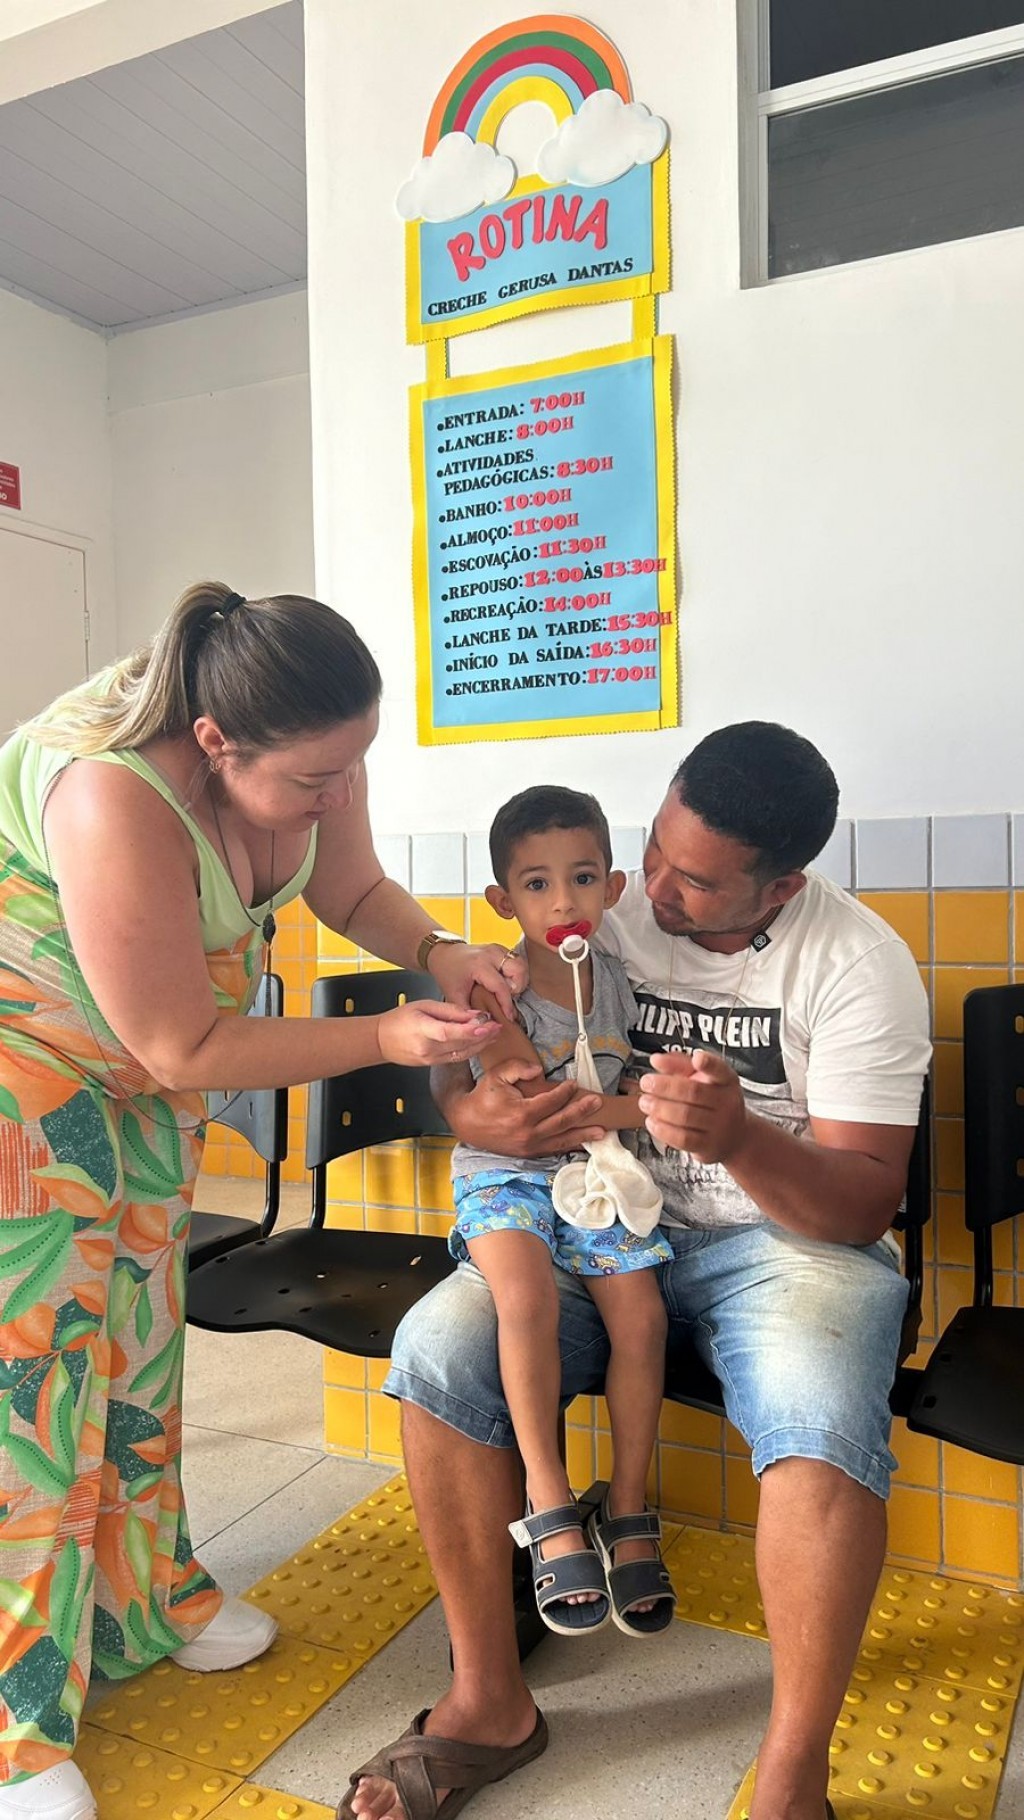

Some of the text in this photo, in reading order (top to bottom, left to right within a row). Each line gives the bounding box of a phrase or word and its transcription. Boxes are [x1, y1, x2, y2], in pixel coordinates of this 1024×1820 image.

[448, 195, 608, 281] ROTINA
[428, 258, 633, 316] CRECHE GERUSA DANTAS
[445, 392, 585, 430] ENTRADA: 7:00H
[445, 416, 574, 453] LANCHE: 8:00H
[443, 449, 534, 477] ATIVIDADES
[444, 456, 613, 496] PEDAGÓGICAS: 8:30H
[446, 488, 572, 522] BANHO: 10:00H
[447, 513, 579, 548] ALMOÇO: 11:00H
[538, 536, 607, 558] 11:30H
[449, 575, 524, 600] REPOUSO:
[450, 592, 611, 623] RECREAÇÃO: 14:00H
[452, 611, 673, 649] LANCHE DA TARDE: 15:30H
[453, 638, 657, 672] INÍCIO DA SAÍDA: 16:30H
[453, 666, 656, 696] ENCERRAMENTO: 17:00H
[636, 1003, 771, 1049] ILIPP PLEIN
